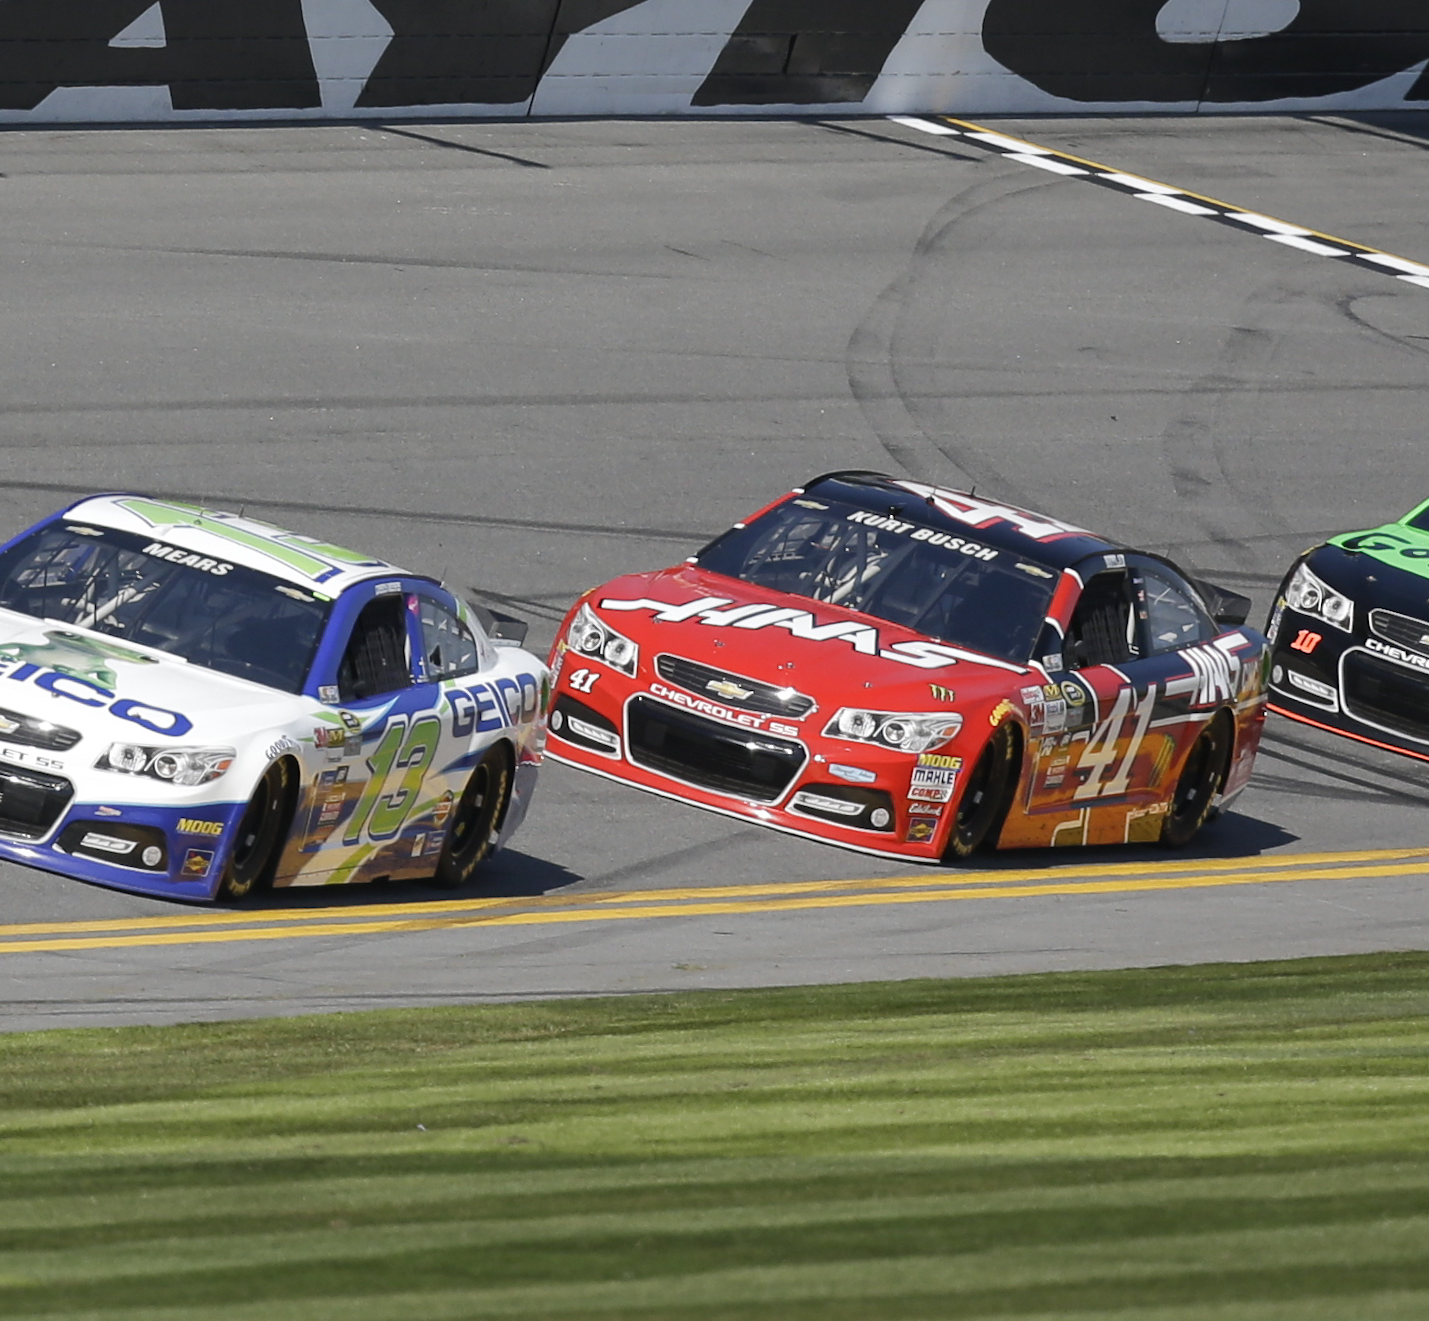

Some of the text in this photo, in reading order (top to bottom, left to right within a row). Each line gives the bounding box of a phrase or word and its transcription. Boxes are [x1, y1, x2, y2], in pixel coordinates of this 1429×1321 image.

[847, 511, 999, 561] KURT BUSCH
[142, 542, 234, 576] MEARS
[601, 595, 1029, 674] HAAS
[1291, 629, 1324, 655] 10
[569, 668, 602, 694] 41
[444, 672, 538, 738] GEICO
[650, 683, 799, 737] CHEVROLET SS
[1073, 681, 1158, 799] 41
[37, 756, 64, 770] SS
[914, 768, 955, 785] MAHLE
[918, 754, 962, 769] MOOG
[342, 711, 441, 846] 13
[911, 787, 942, 799] COMP
[177, 818, 224, 836] MOOG
